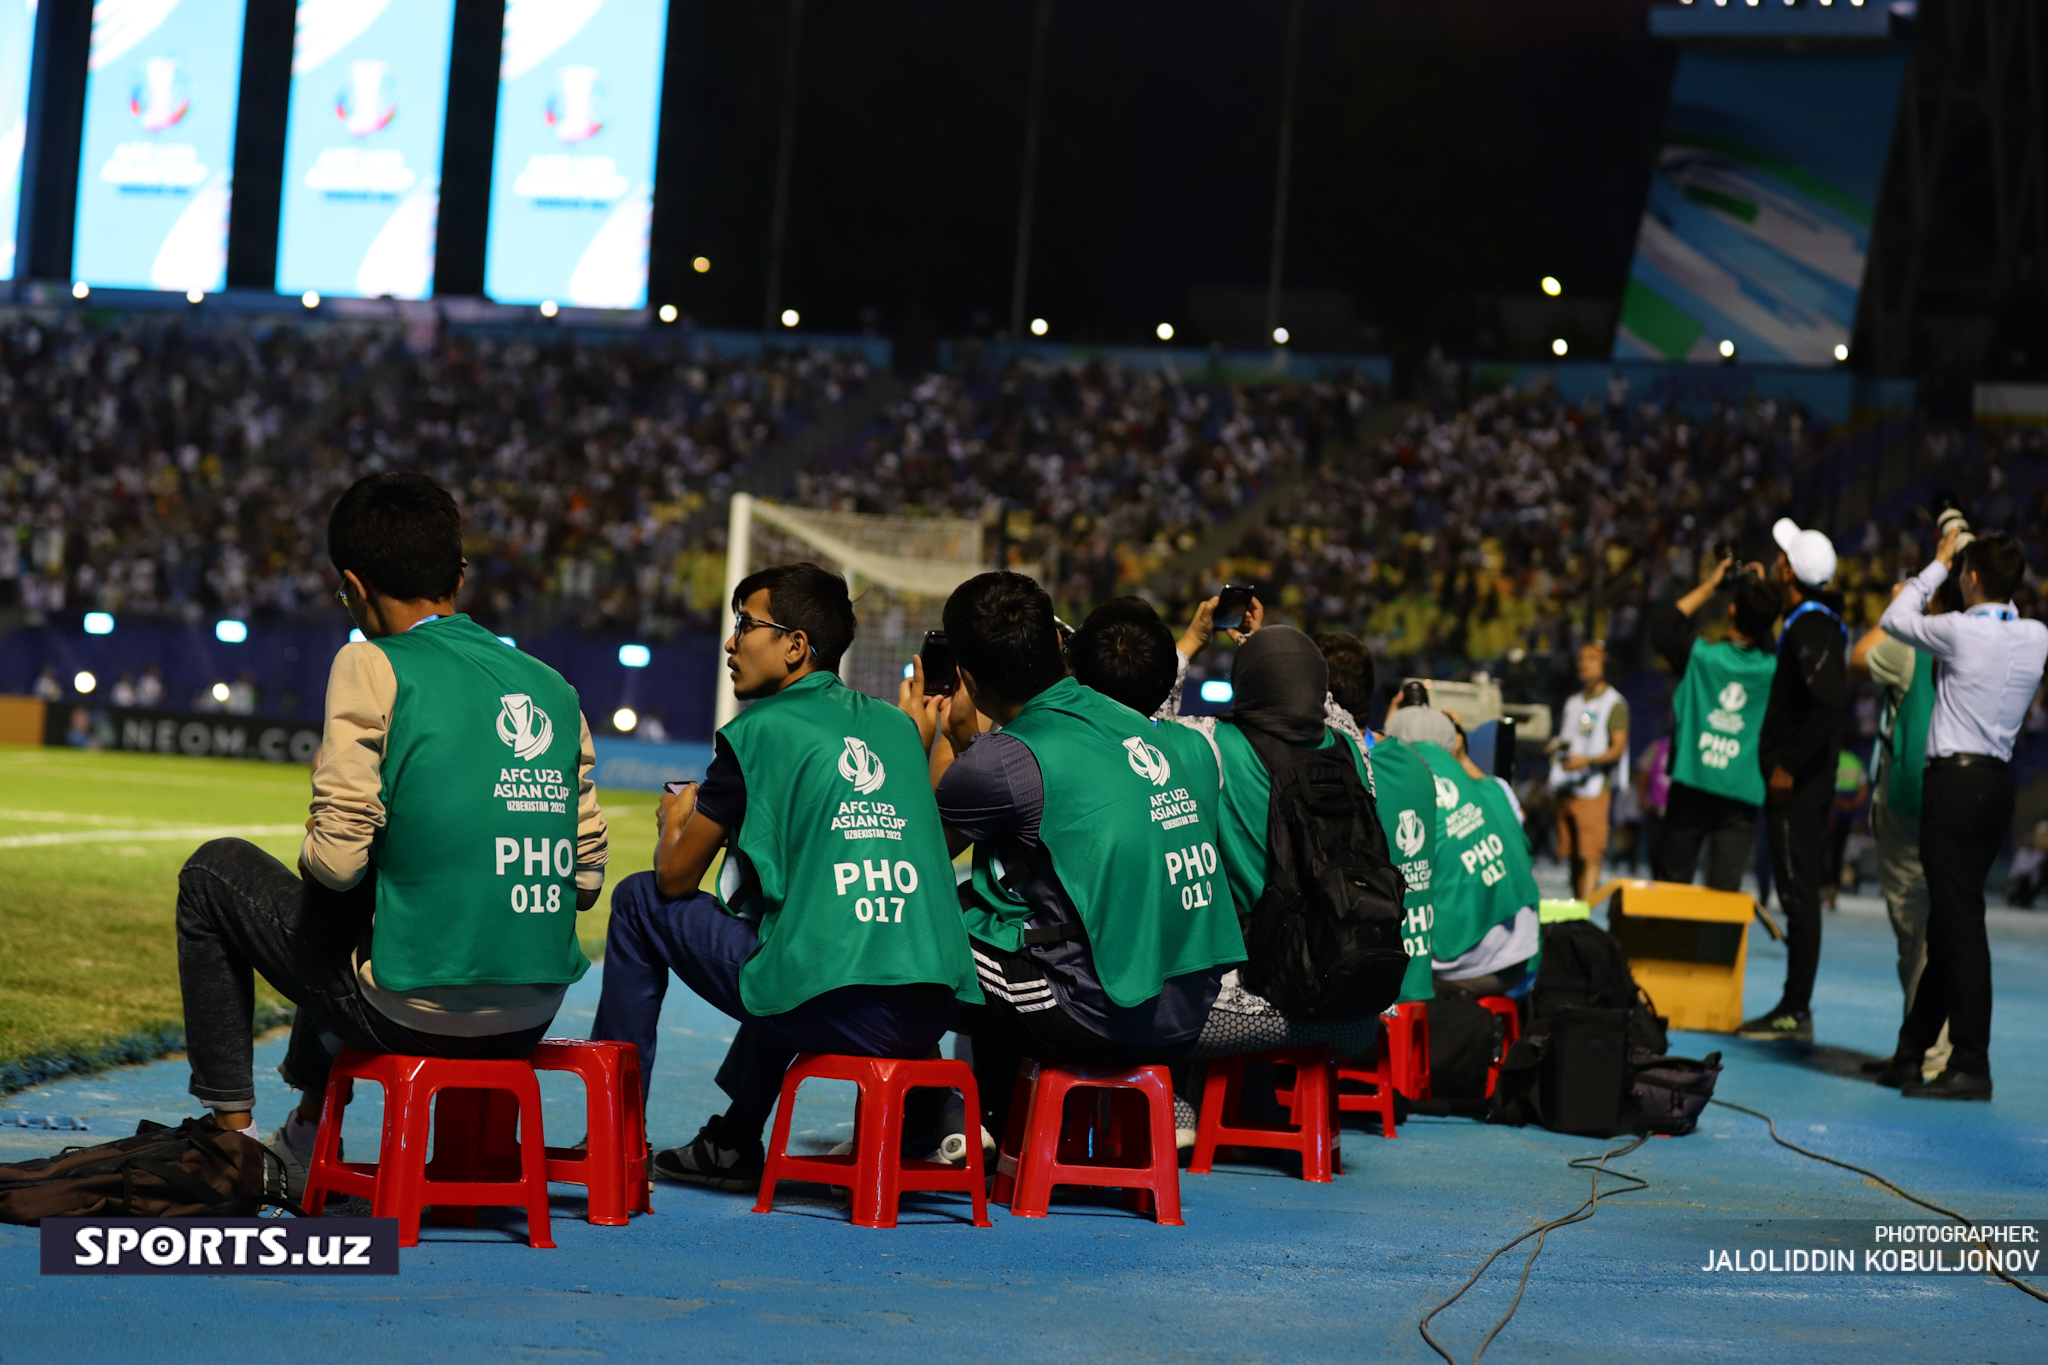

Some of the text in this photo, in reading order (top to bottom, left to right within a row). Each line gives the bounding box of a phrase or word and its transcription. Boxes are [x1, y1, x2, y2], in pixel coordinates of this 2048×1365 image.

[122, 717, 323, 763] NEOM.CO
[1698, 731, 1740, 759] PHO
[500, 768, 563, 784] AFC U23
[493, 783, 570, 800] ASIAN CUP
[1149, 788, 1189, 808] AFC U23
[506, 800, 566, 814] UZBEKISTAN 2022
[838, 801, 896, 816] AFC U23
[1150, 799, 1197, 823] ASIAN CUP
[831, 815, 907, 831] ASIAN CUP
[844, 829, 902, 841] UZBEKISTAN 2022
[495, 837, 573, 878] PHO
[1164, 841, 1217, 886] PHO
[1460, 833, 1504, 875] PHO
[833, 859, 919, 896] PHO
[511, 884, 561, 913] 018
[855, 896, 906, 923] 017
[1401, 903, 1434, 934] HO
[1403, 933, 1431, 957] 01
